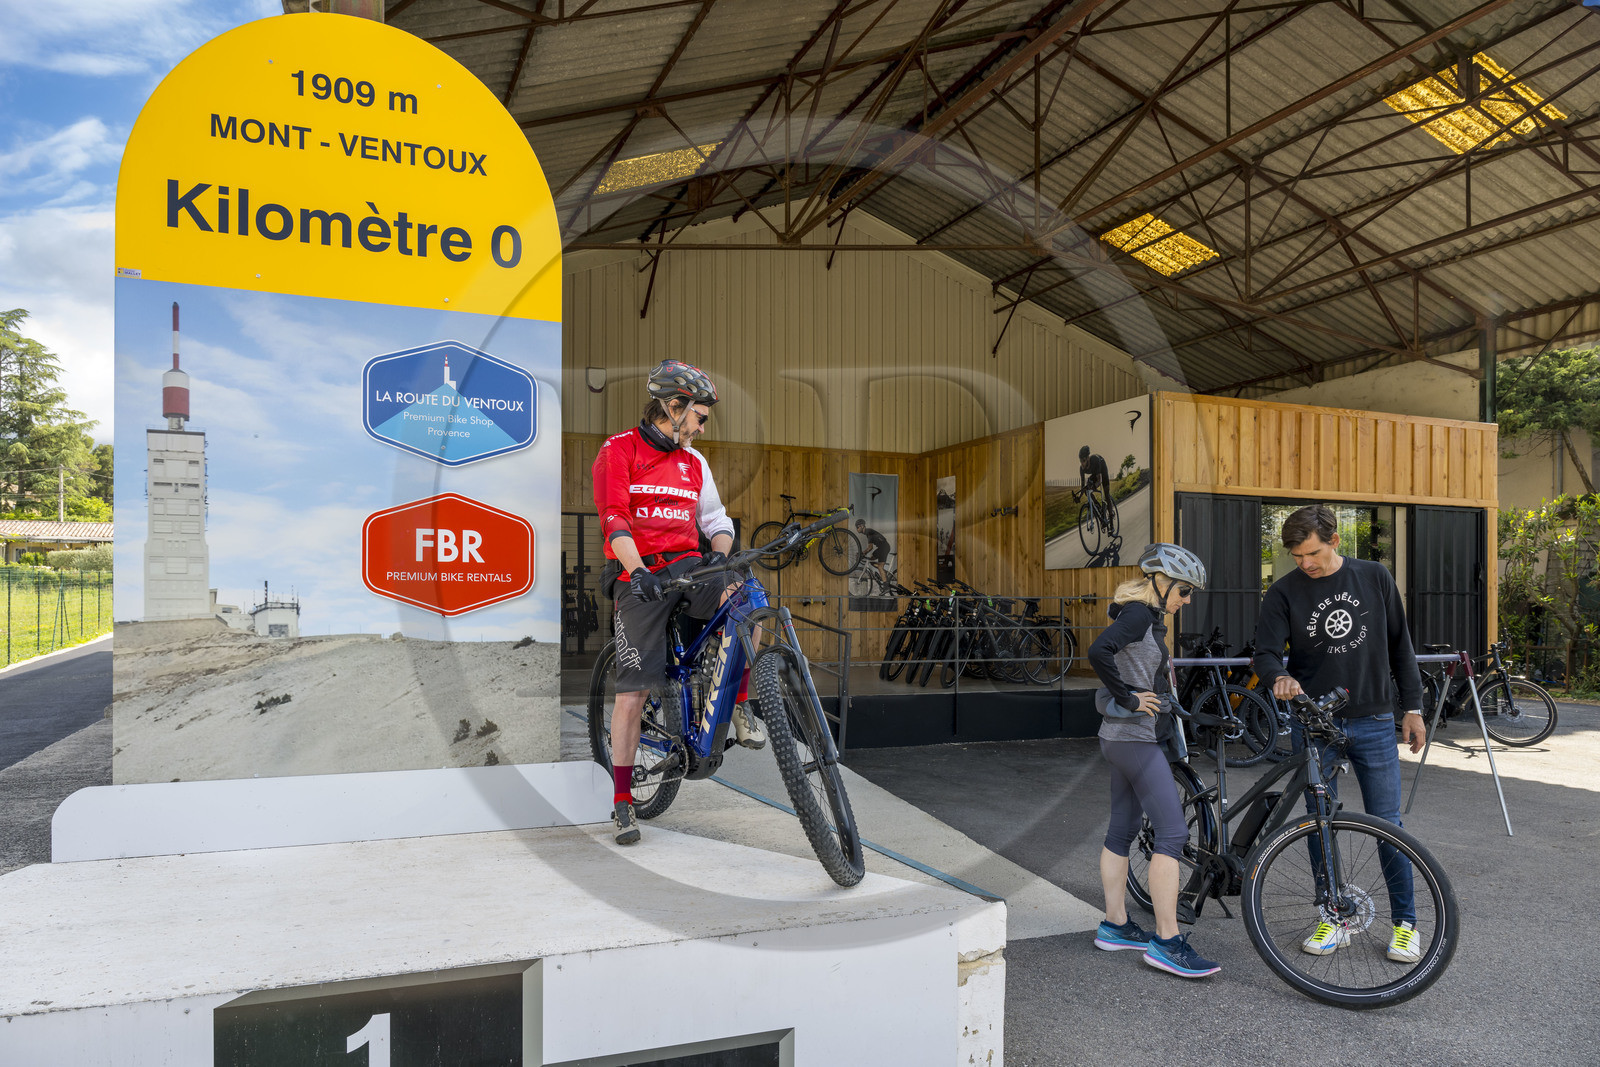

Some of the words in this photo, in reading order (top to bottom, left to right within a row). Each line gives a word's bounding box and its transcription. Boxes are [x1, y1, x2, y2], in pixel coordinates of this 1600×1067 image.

[291, 69, 376, 107] 1909
[389, 89, 418, 115] m
[210, 113, 312, 151] MONT
[338, 132, 488, 177] VENTOUX
[166, 178, 473, 263] Kilomètre
[490, 224, 523, 269] 0
[376, 390, 392, 403] LA
[396, 392, 438, 406] ROUTE
[443, 395, 460, 408] DU
[463, 396, 524, 413] VENTOUX
[403, 411, 445, 423] Premium
[447, 413, 467, 425] Bike
[470, 415, 494, 428] Shop
[427, 427, 470, 438] Provence
[629, 485, 698, 501] EGOBIKE
[415, 528, 485, 563] FBR
[386, 571, 438, 582] PREMIUM
[441, 572, 464, 582] BIKE
[467, 572, 512, 583] RENTALS
[1318, 598, 1332, 610] DE
[1350, 625, 1368, 649] SHOP
[700, 624, 732, 734] TREK
[346, 1013, 391, 1067] 1
